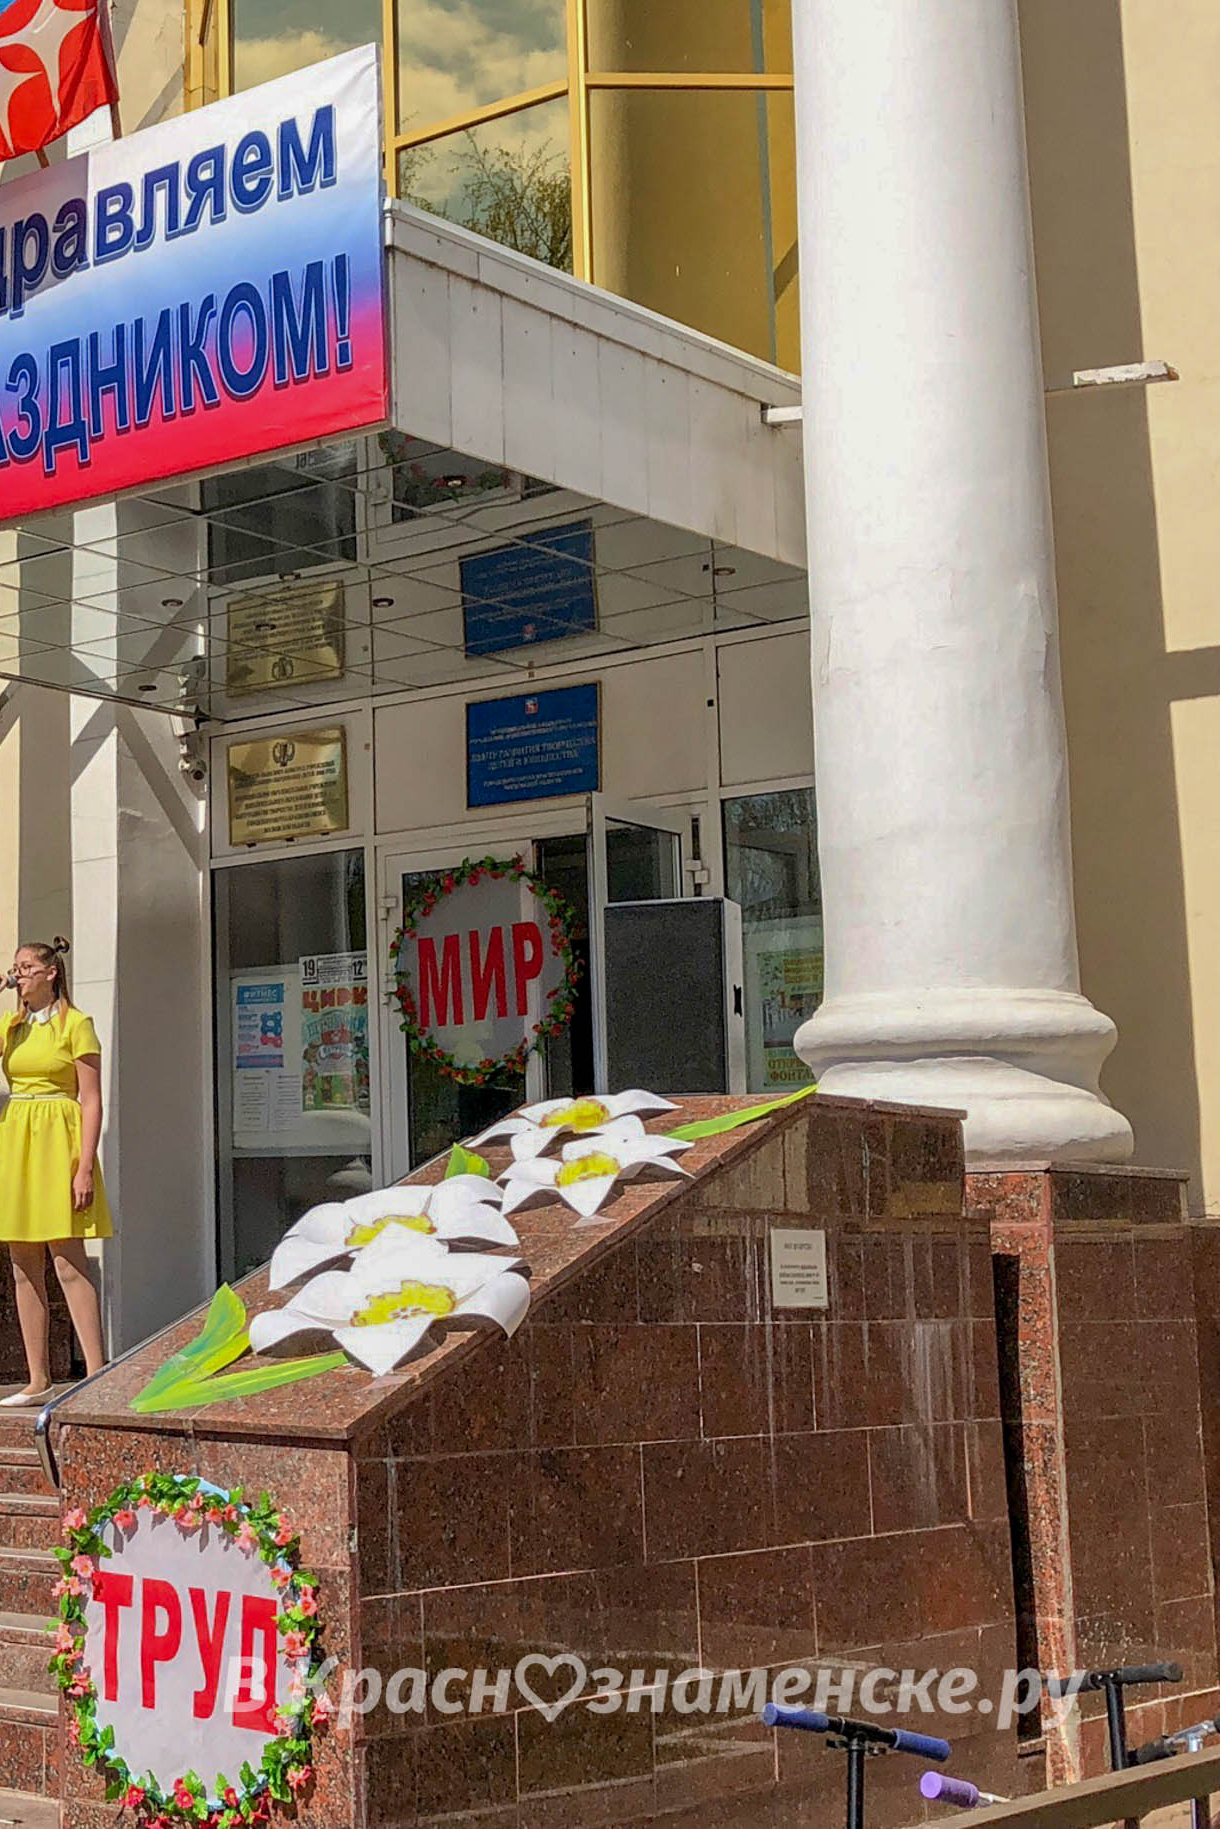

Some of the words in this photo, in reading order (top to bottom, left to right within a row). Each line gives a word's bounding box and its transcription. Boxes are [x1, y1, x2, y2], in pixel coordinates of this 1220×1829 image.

[302, 959, 315, 977] 19
[302, 986, 368, 1013] ЦИРК
[418, 922, 543, 1028] МИР
[92, 1571, 281, 1735] ТРУД
